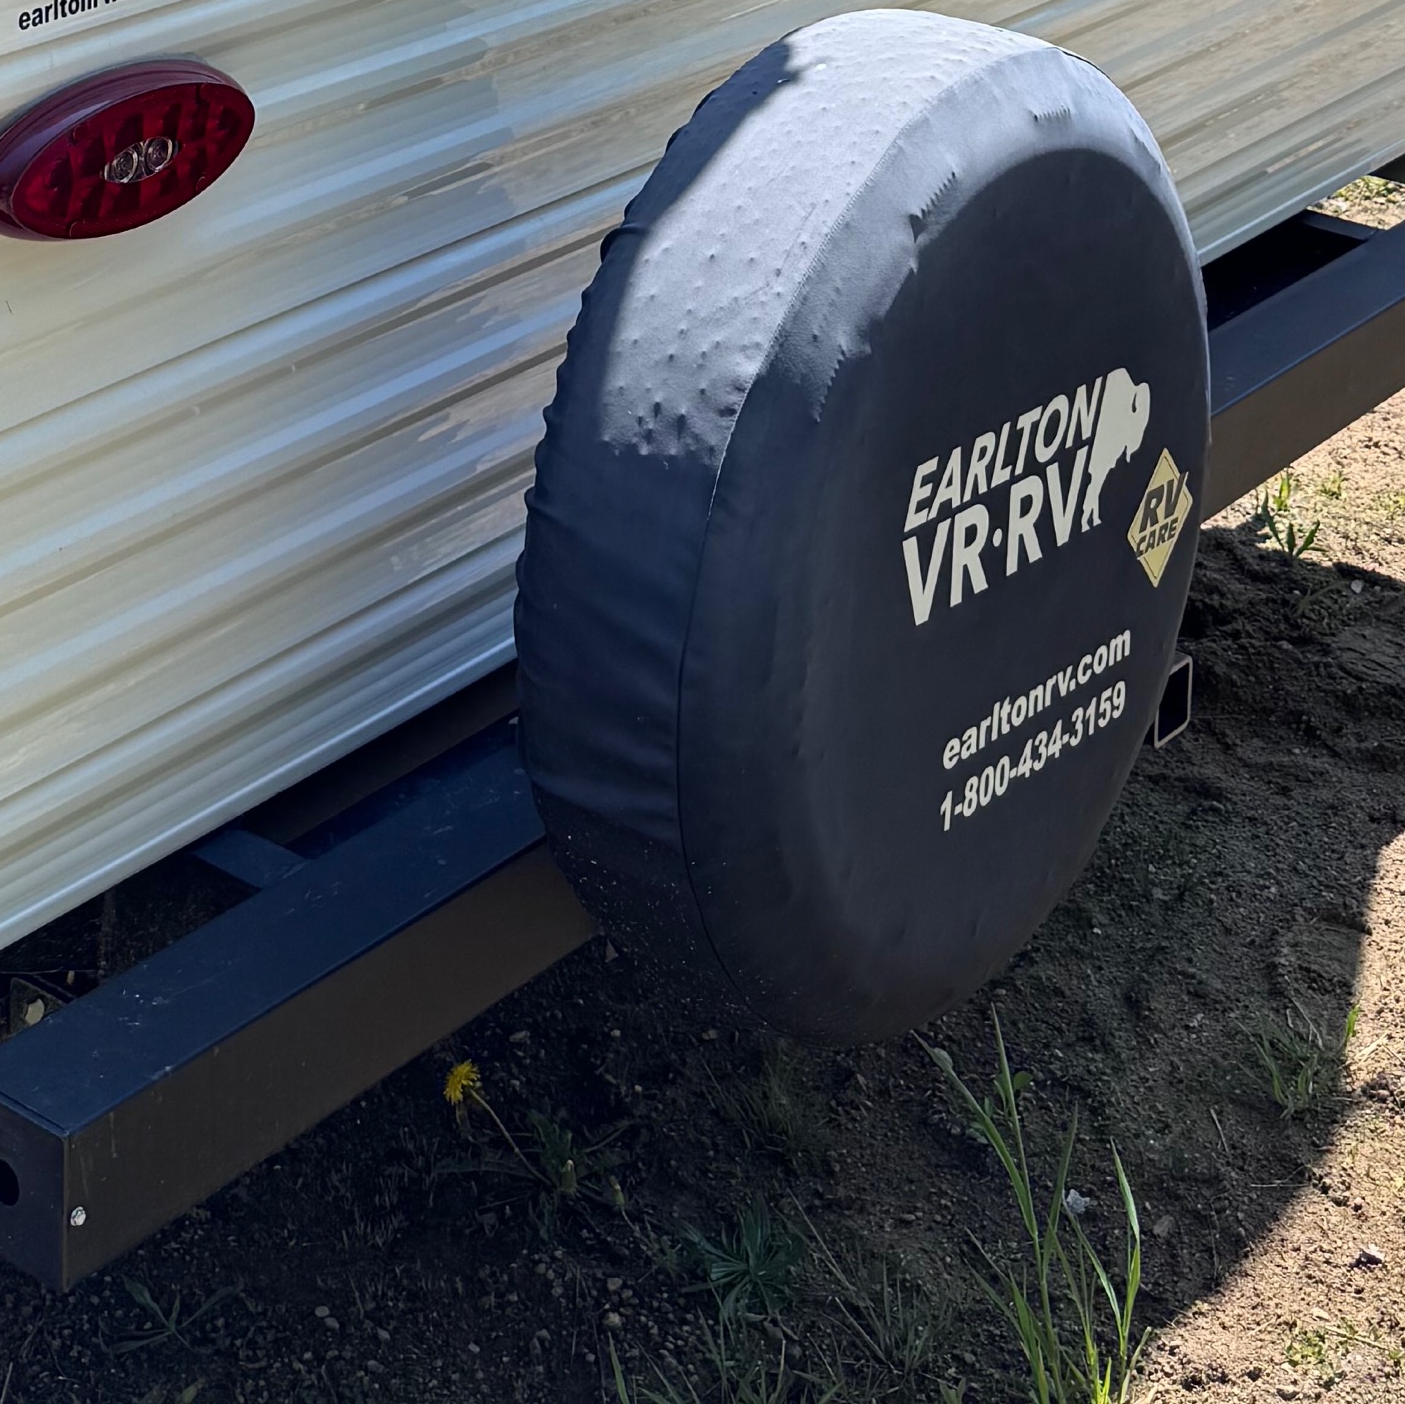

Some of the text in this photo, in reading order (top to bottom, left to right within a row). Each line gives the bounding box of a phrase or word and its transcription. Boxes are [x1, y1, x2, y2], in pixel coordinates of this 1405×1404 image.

[903, 375, 1103, 533] EARLTON
[1139, 472, 1186, 534] RV
[1136, 516, 1179, 558] CARE
[940, 680, 1126, 832] 1-800-434-3159
[942, 629, 1131, 770] earltonrv.com
